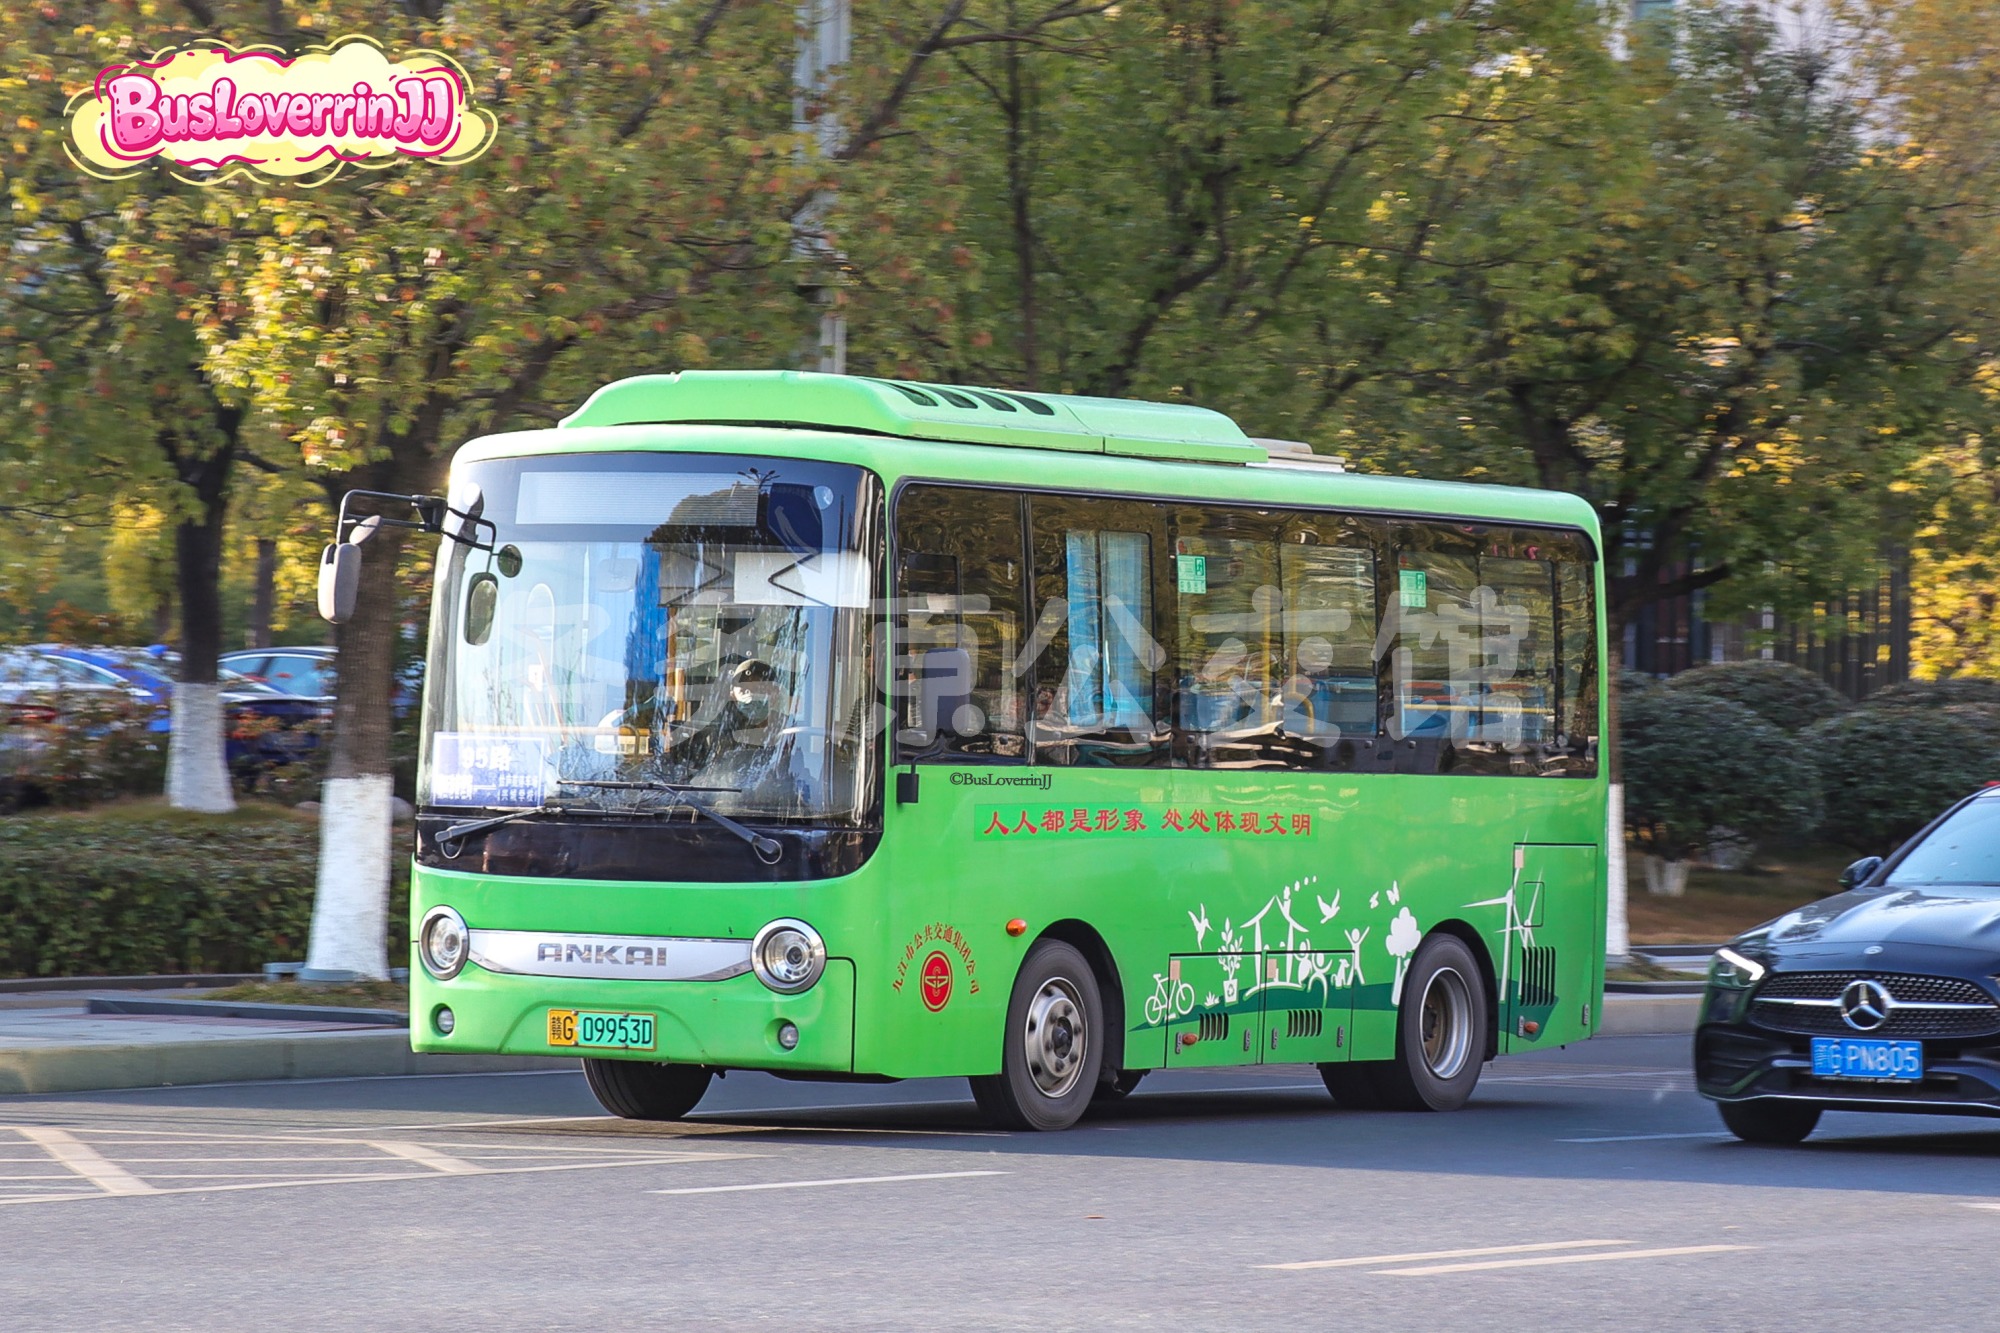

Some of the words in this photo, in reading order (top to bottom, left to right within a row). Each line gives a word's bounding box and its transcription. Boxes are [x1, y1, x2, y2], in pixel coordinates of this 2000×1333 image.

[983, 808, 1147, 836] 人人都是形象
[1160, 808, 1312, 836] 处处体现文明
[537, 942, 668, 967] ANKAI
[892, 921, 980, 995] 九江市公共交通集团公司
